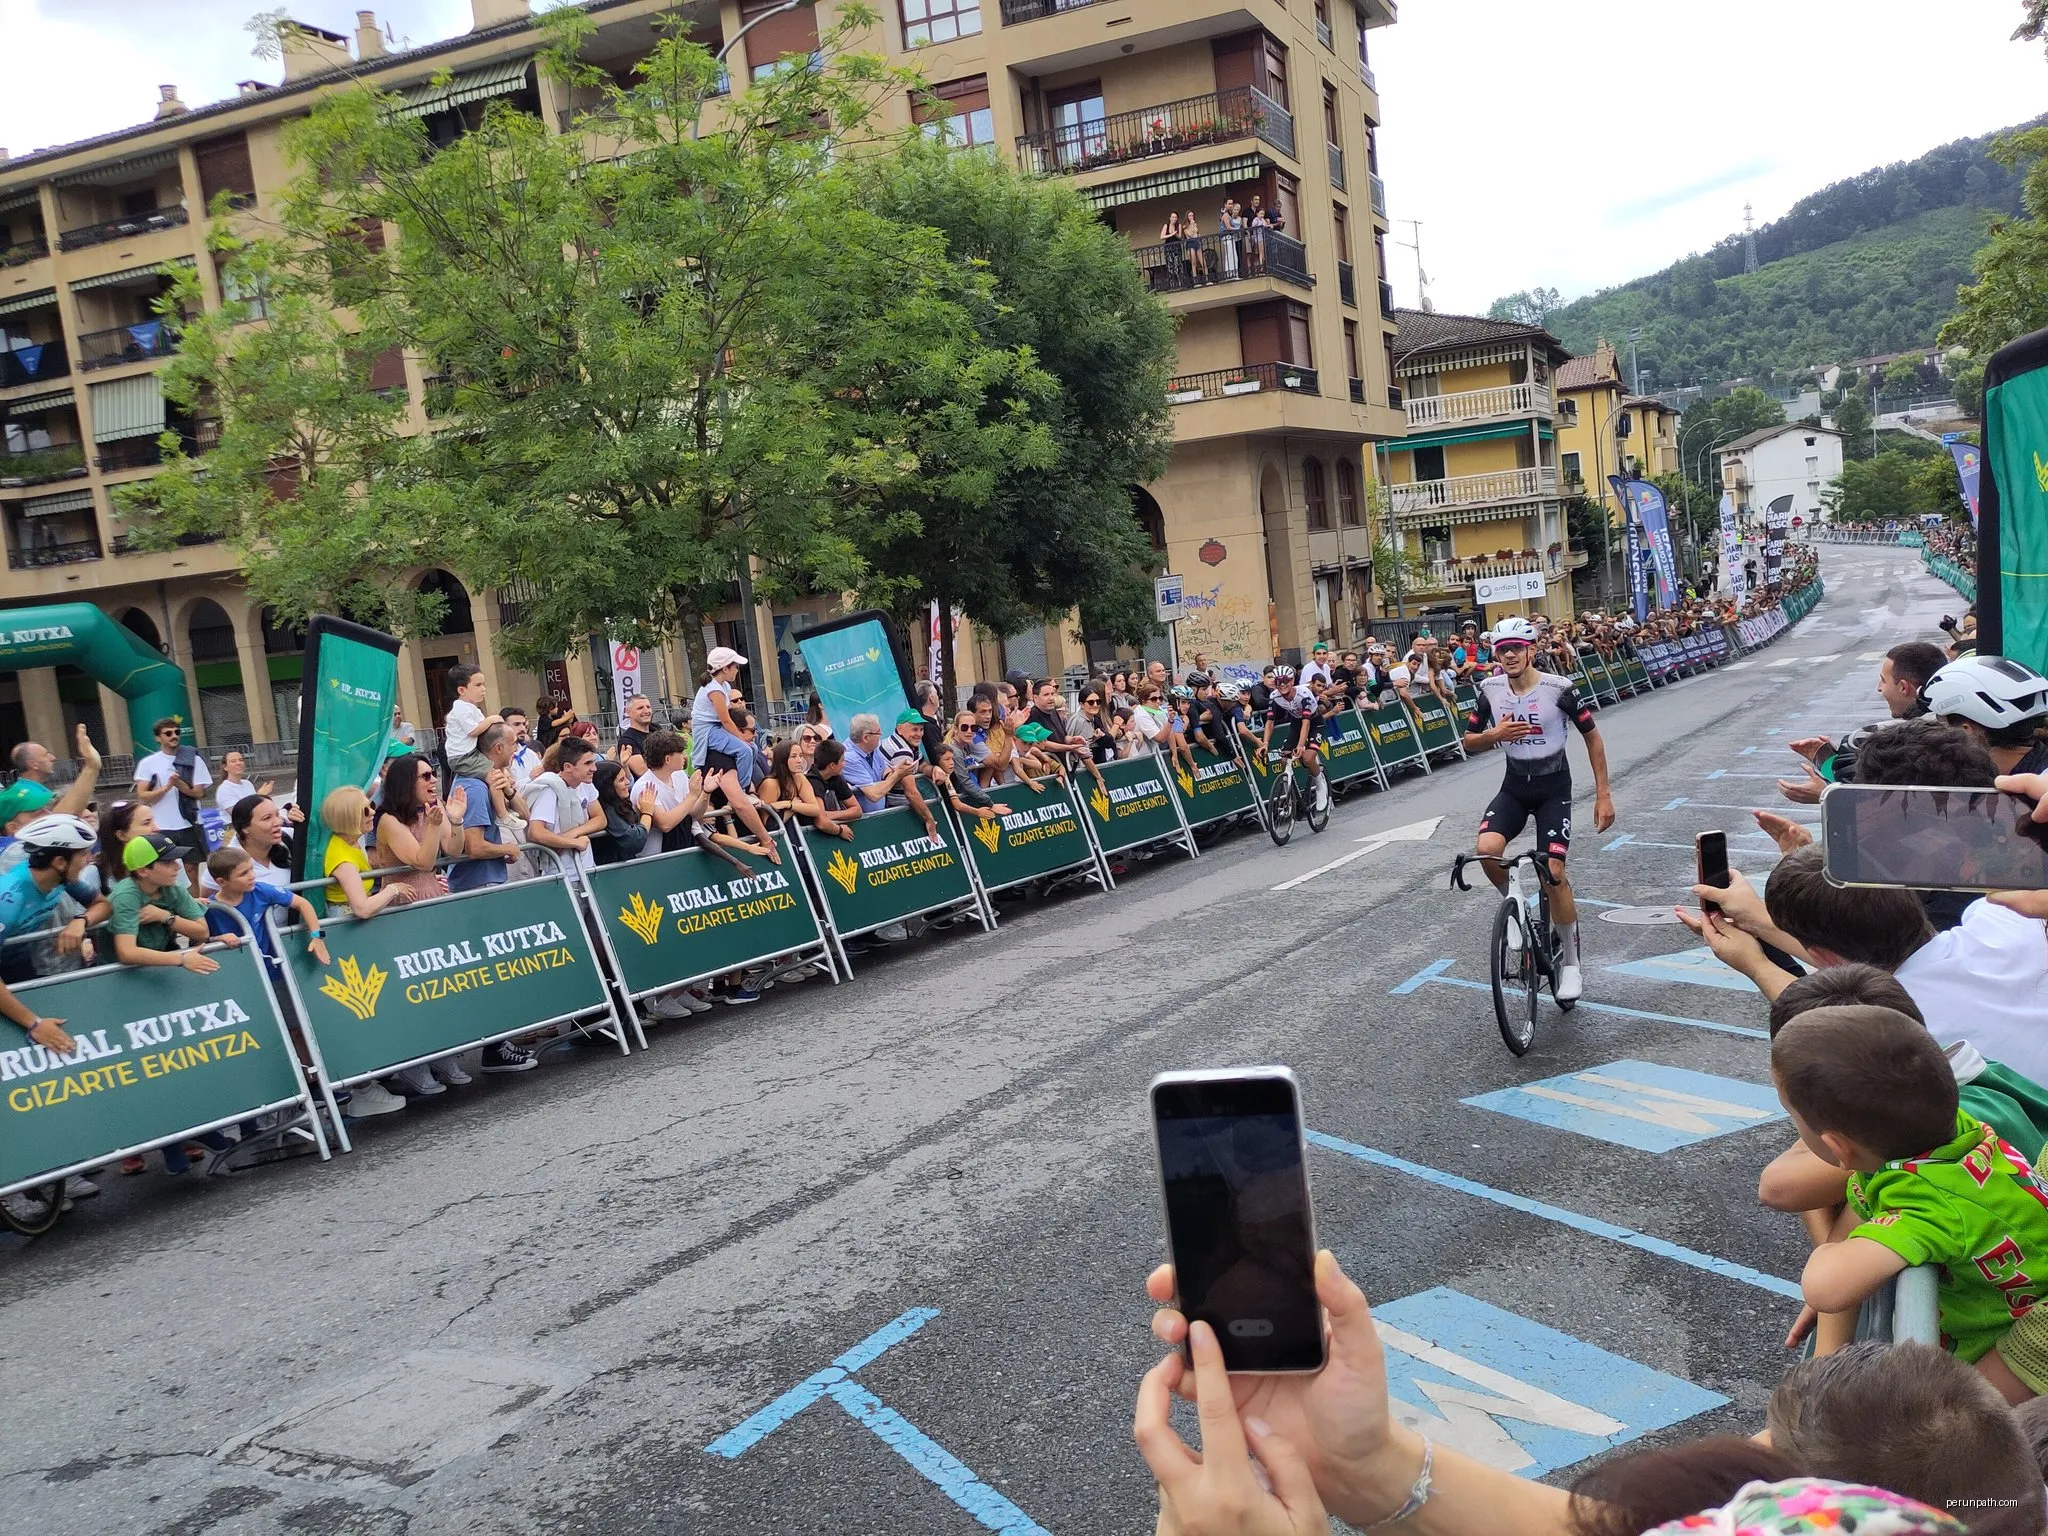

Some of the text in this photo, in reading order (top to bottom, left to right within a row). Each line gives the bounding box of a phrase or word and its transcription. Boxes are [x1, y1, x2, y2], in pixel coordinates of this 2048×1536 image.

[1766, 512, 1787, 521] DIARI
[1767, 520, 1786, 529] VASC
[1526, 580, 1538, 590] 50
[12, 625, 74, 644] KUTXA
[547, 669, 562, 682] RE
[553, 689, 568, 702] BA
[1214, 760, 1238, 775] KUTXA
[1108, 779, 1163, 803] RURAL KUTXA
[1199, 774, 1243, 794] GIZARTE EKINTZA
[1001, 802, 1072, 831] RURAL KUTXA
[1116, 795, 1168, 817] GIZARTE EKINTZA
[1009, 820, 1078, 847] GIZARTE EKINTZA
[859, 844, 903, 869] RURAL
[868, 852, 954, 887] GIZARTE EKINTZA
[667, 870, 789, 914] RURAL KUTXA
[677, 892, 797, 935] GIZARTE EKINTZA
[394, 921, 567, 979] RURAL KUTXA
[405, 947, 576, 1004] GIZARTE EKINTZA
[124, 998, 250, 1049] KUTXA
[9, 1031, 261, 1112] GIZARTE EKINTZA
